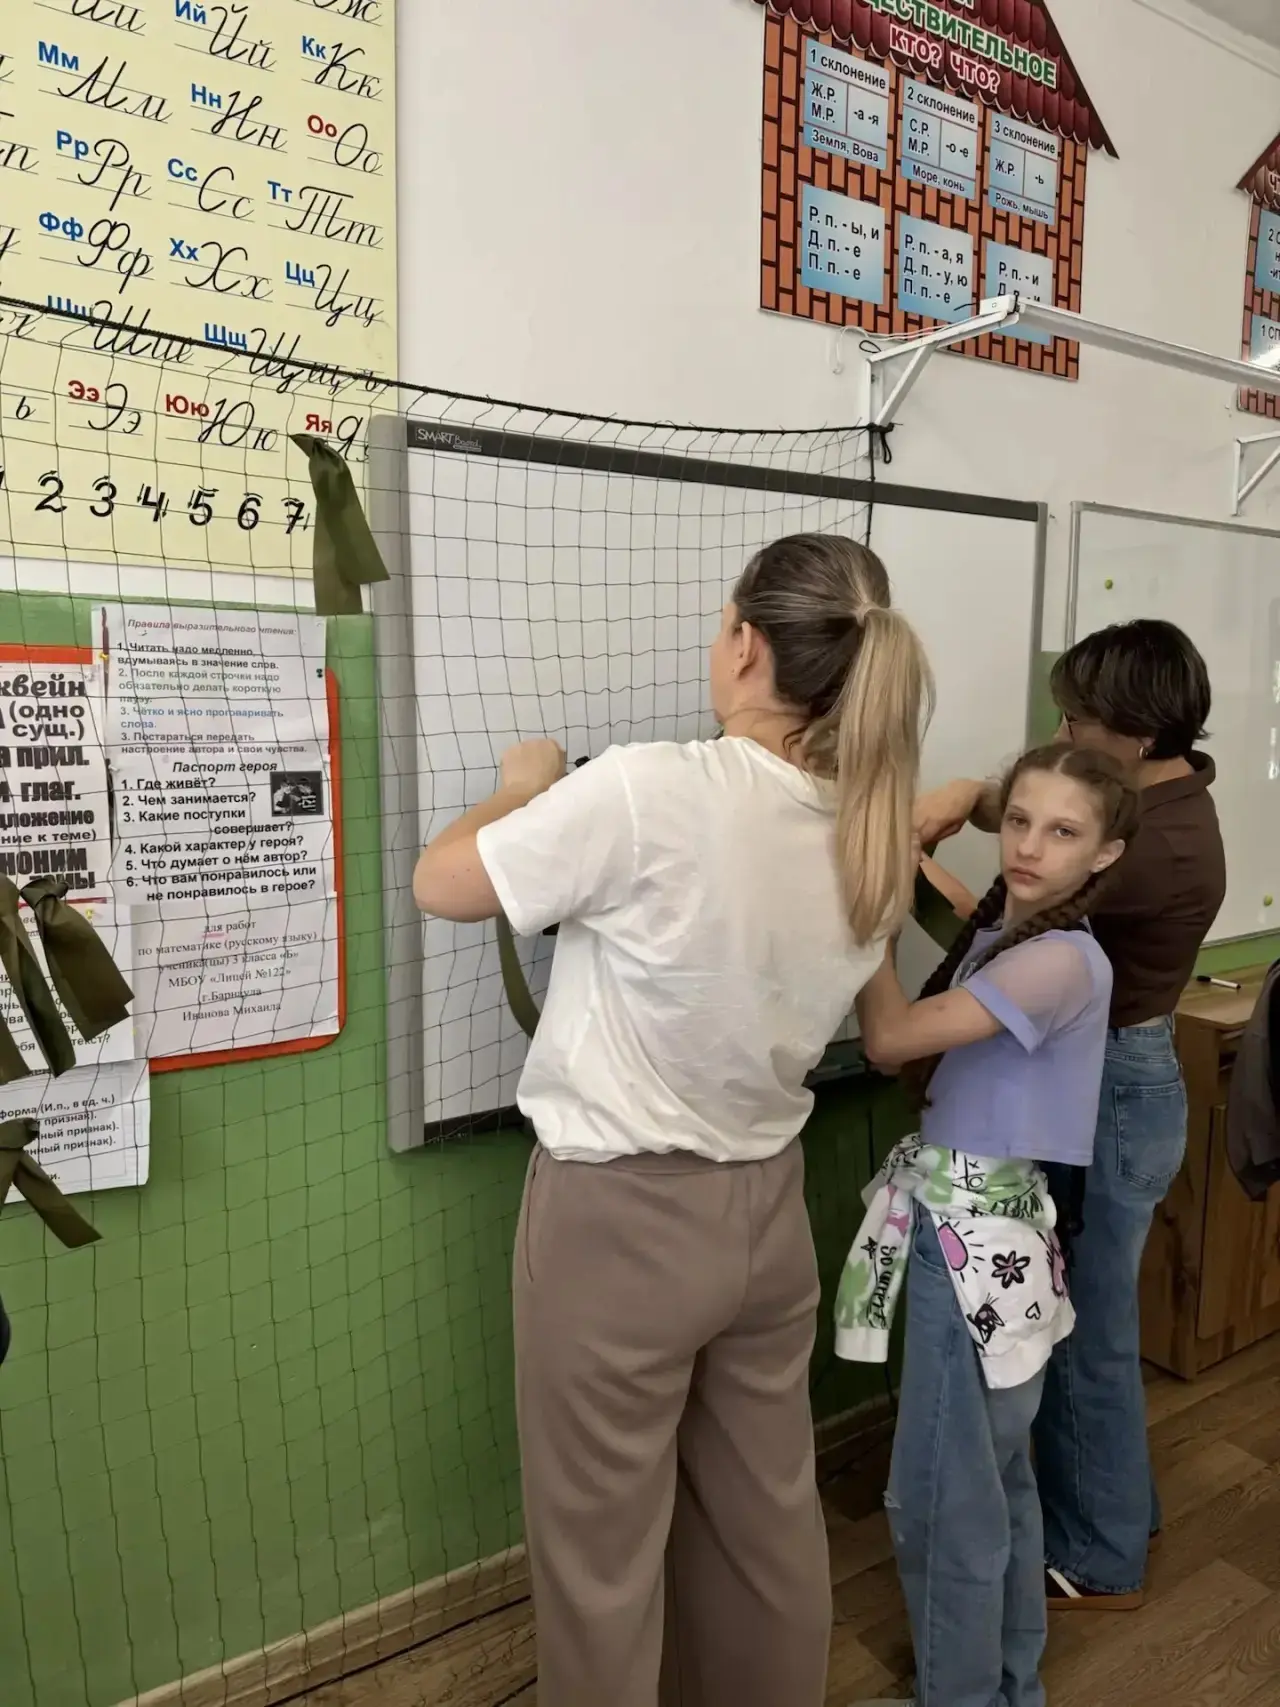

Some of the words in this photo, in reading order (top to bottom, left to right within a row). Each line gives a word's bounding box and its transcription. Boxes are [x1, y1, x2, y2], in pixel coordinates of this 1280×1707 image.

[38, 41, 79, 71] Мм
[302, 35, 327, 59] Кк
[890, 24, 942, 68] КТО?
[950, 52, 1000, 93] ЧТО?
[810, 49, 816, 63] 1
[820, 56, 887, 90] склонение
[191, 83, 222, 109] Нн
[811, 81, 837, 103] Ж.Р.
[811, 102, 836, 123] М.Р.
[907, 86, 914, 100] 2
[917, 93, 976, 124] склонение
[307, 114, 338, 138] Оо
[909, 118, 930, 137] С.Р.
[56, 130, 89, 159] Рр
[812, 129, 850, 154] Земля,
[852, 143, 879, 162] Вова
[908, 137, 930, 156] М.Р.
[995, 120, 1001, 134] 3
[1003, 127, 1056, 154] склонение
[167, 158, 198, 181] Сс
[995, 158, 1016, 177] Ж.Р.
[912, 164, 941, 185] Море,
[943, 176, 965, 192] конь
[267, 180, 293, 203] Тт
[995, 193, 1021, 212] Рожь,
[1022, 204, 1049, 219] мышь
[38, 212, 84, 241] Фф
[872, 228, 879, 240] и
[169, 237, 199, 262] Хх
[854, 246, 860, 257] е
[956, 253, 963, 264] я
[285, 261, 316, 288] Цц
[853, 269, 860, 280] е
[958, 275, 968, 287] ю
[944, 292, 950, 303] е
[204, 323, 248, 350] Щщ
[68, 380, 100, 402] Ээ
[166, 394, 209, 417] Юю
[305, 414, 332, 433] Яя
[418, 428, 455, 444] SMART
[35, 476, 68, 512] 2
[89, 482, 117, 517] 3
[142, 486, 166, 522] 4
[189, 490, 215, 526] 5
[237, 497, 261, 530] 6
[284, 501, 305, 534] 7
[128, 619, 170, 631] Правила
[172, 622, 256, 633] выразительного
[130, 642, 169, 653] Читать
[118, 657, 188, 668] вдумываясь
[201, 659, 248, 669] значение
[251, 660, 279, 670] слов.
[132, 669, 165, 679] После
[168, 669, 208, 681] каждой
[210, 672, 252, 683] строчки
[254, 674, 280, 682] надо
[119, 681, 189, 691] обязательно
[192, 683, 229, 693] делать
[232, 685, 281, 695] короткую
[9, 701, 85, 723] (одно
[177, 708, 203, 717] ясно
[206, 709, 284, 720] проговаривать
[12, 720, 85, 741] сущ.)
[121, 720, 157, 729] слова.
[133, 732, 203, 742] Постараться
[206, 733, 255, 743] передать
[17, 746, 90, 769] прил.
[121, 746, 185, 755] настроение
[188, 745, 225, 754] автора
[237, 745, 263, 753] свои
[173, 762, 236, 773] Паспорт
[240, 762, 277, 773] героя
[20, 781, 81, 801] глаг.
[121, 780, 133, 790] 1.
[137, 779, 161, 790] Где
[166, 777, 215, 789] живёт?
[123, 796, 134, 806] 2.
[138, 795, 166, 805] Чем
[170, 792, 256, 804] занимается?
[123, 813, 135, 822] 3.
[139, 811, 180, 822] Какие
[184, 810, 245, 822] поступки
[52, 829, 97, 842] теме)
[214, 821, 292, 835] совершает?
[125, 845, 136, 855] 4.
[140, 842, 181, 854] Какой
[185, 839, 246, 852] характер
[260, 836, 304, 849] героя?
[126, 861, 137, 871] 5.
[141, 859, 166, 869] Что
[170, 856, 218, 869] думает
[235, 852, 260, 863] нём
[263, 850, 308, 864] автор?
[126, 877, 138, 887] 6.
[142, 875, 166, 885] Что
[172, 873, 197, 883] вам
[201, 868, 289, 882] понравилось
[293, 866, 316, 876] или
[147, 891, 163, 901] не
[167, 885, 256, 900] понравилось
[272, 879, 316, 893] герое?
[204, 924, 224, 933] для
[226, 921, 256, 935] работ
[138, 947, 152, 956] по
[156, 942, 221, 954] математике
[224, 935, 278, 950] (русскому
[282, 931, 317, 944] языку)
[242, 951, 276, 963] класса
[169, 974, 207, 988] МБОУ
[210, 970, 252, 983] «Лицей
[255, 968, 291, 978] №122»
[202, 988, 262, 1002] г.Барнаула
[183, 1009, 230, 1021] Иванова
[233, 1003, 281, 1015] Михаила
[101, 1094, 115, 1104] ч.)
[44, 1111, 97, 1126] признак).
[66, 1121, 119, 1137] признак).
[64, 1136, 116, 1151] признак).
